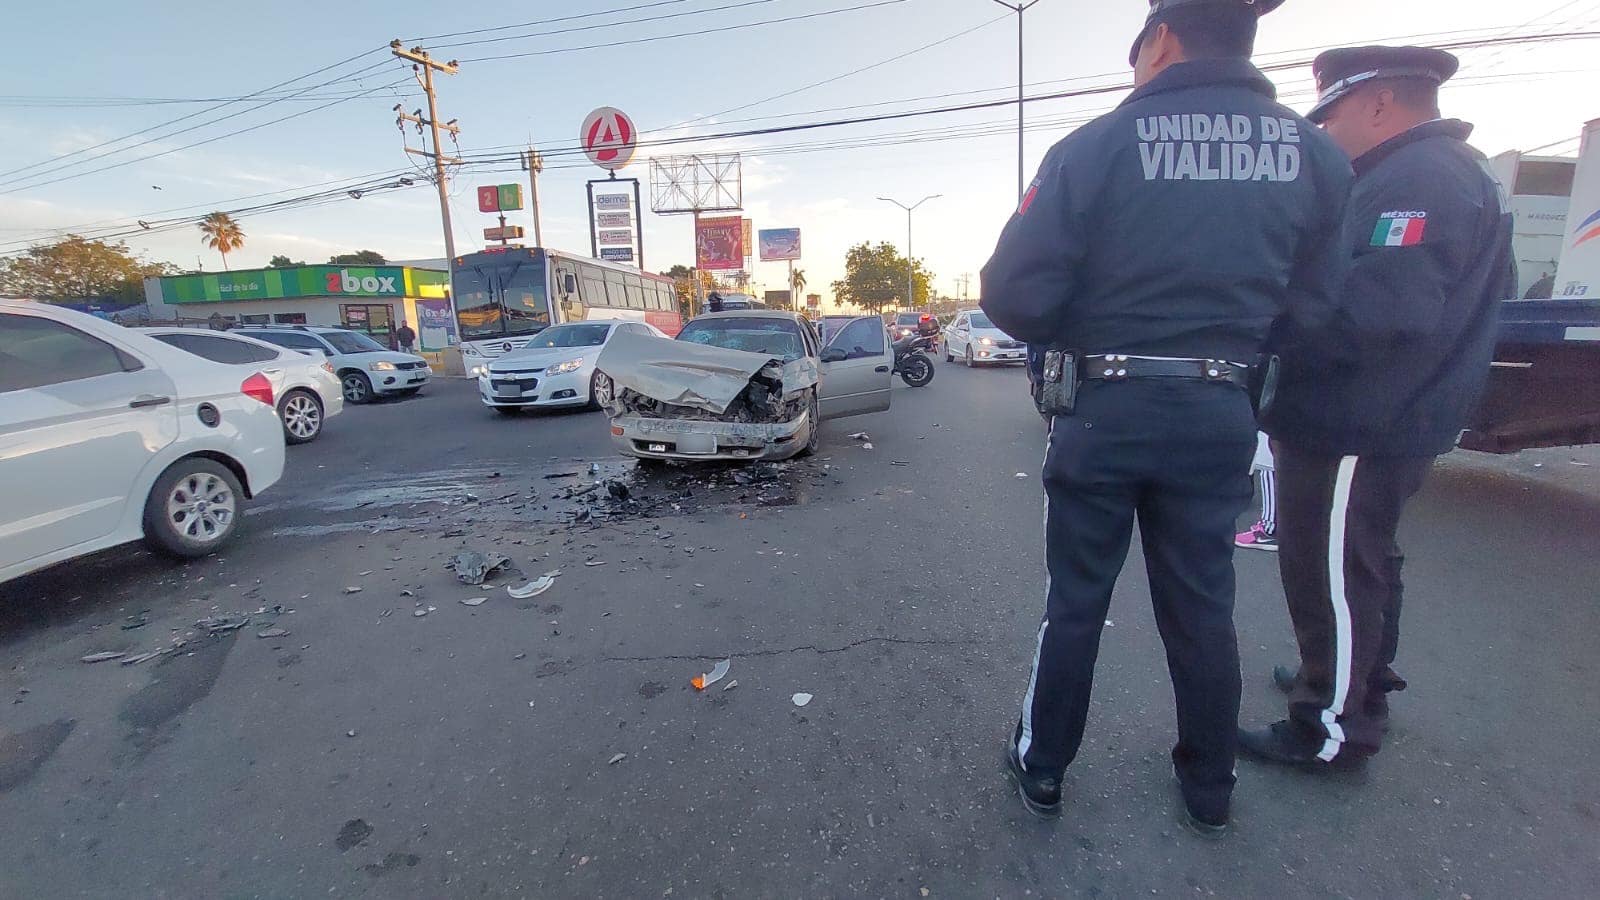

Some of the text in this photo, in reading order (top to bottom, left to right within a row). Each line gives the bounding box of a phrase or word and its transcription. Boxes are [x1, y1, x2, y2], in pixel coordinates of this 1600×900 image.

[1136, 114, 1300, 143] UNIDAD DE
[1138, 142, 1301, 182] VIALIDAD
[483, 191, 493, 206] 2
[1380, 209, 1426, 219] MÉXICO
[1562, 285, 1588, 296] 03
